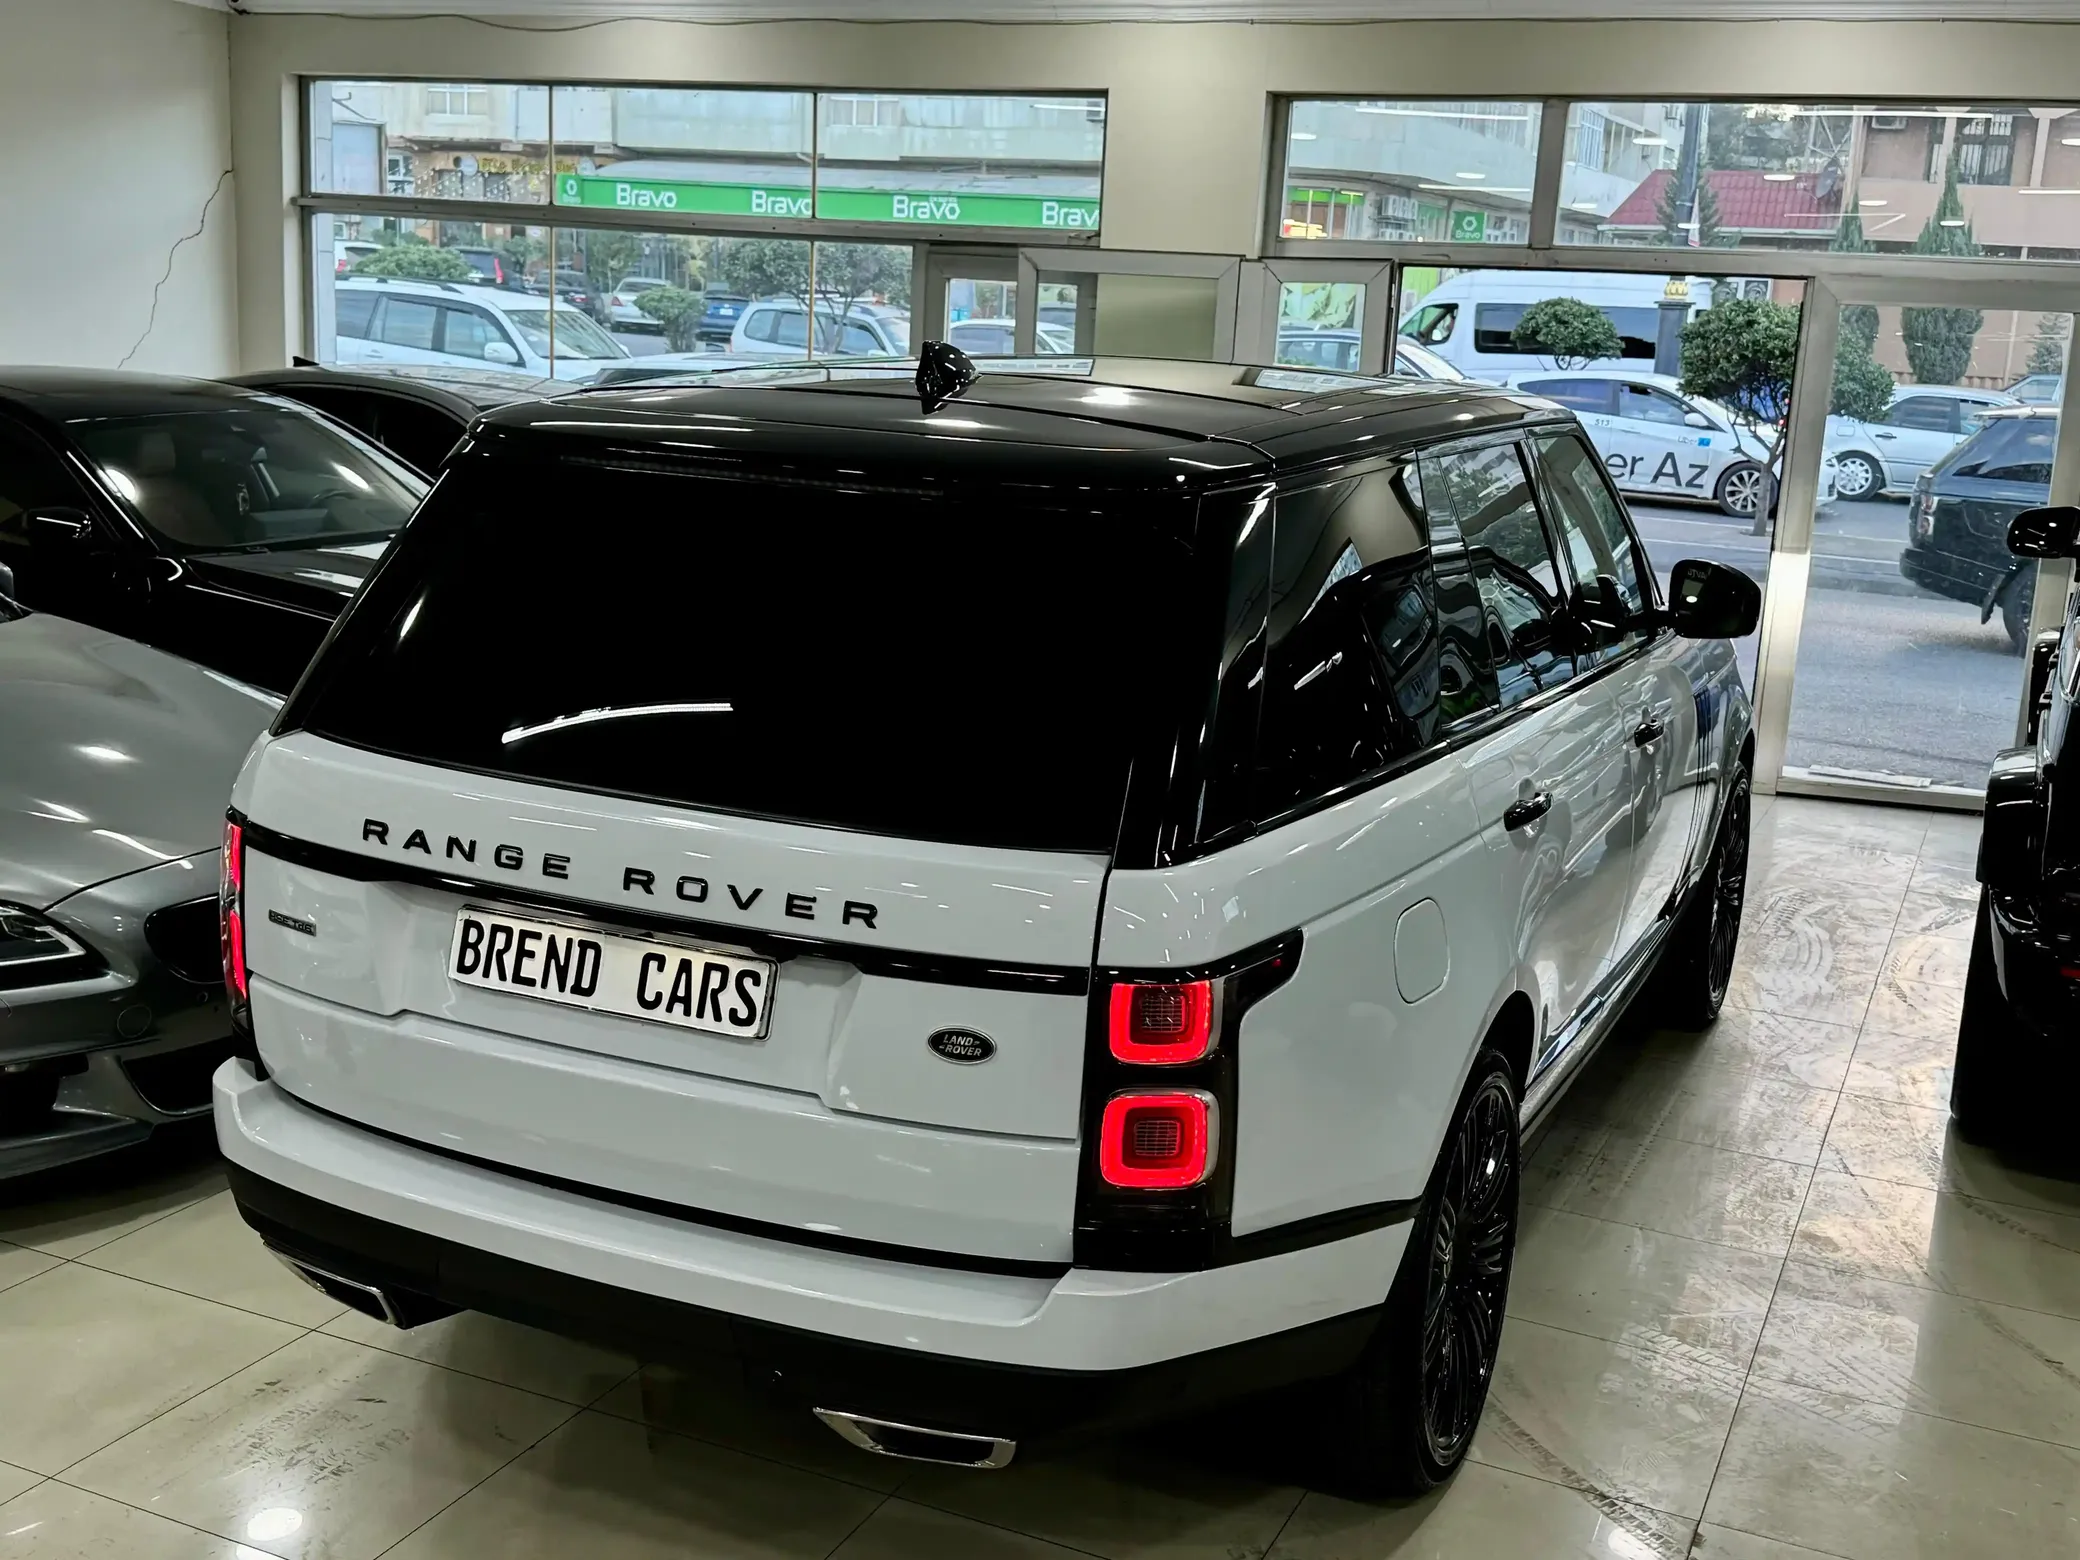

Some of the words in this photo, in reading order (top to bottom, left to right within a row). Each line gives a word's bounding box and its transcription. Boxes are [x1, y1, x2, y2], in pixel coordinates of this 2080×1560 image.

[616, 182, 677, 208] Bravo
[893, 195, 960, 220] Bravo
[1042, 201, 1099, 227] Brav
[1650, 452, 1709, 489] Az
[363, 818, 571, 880] RANGE
[623, 866, 878, 929] ROVER
[456, 919, 602, 998] BREND
[636, 952, 762, 1028] CARS
[943, 1034, 974, 1046] LAND
[944, 1044, 982, 1057] ROVER
